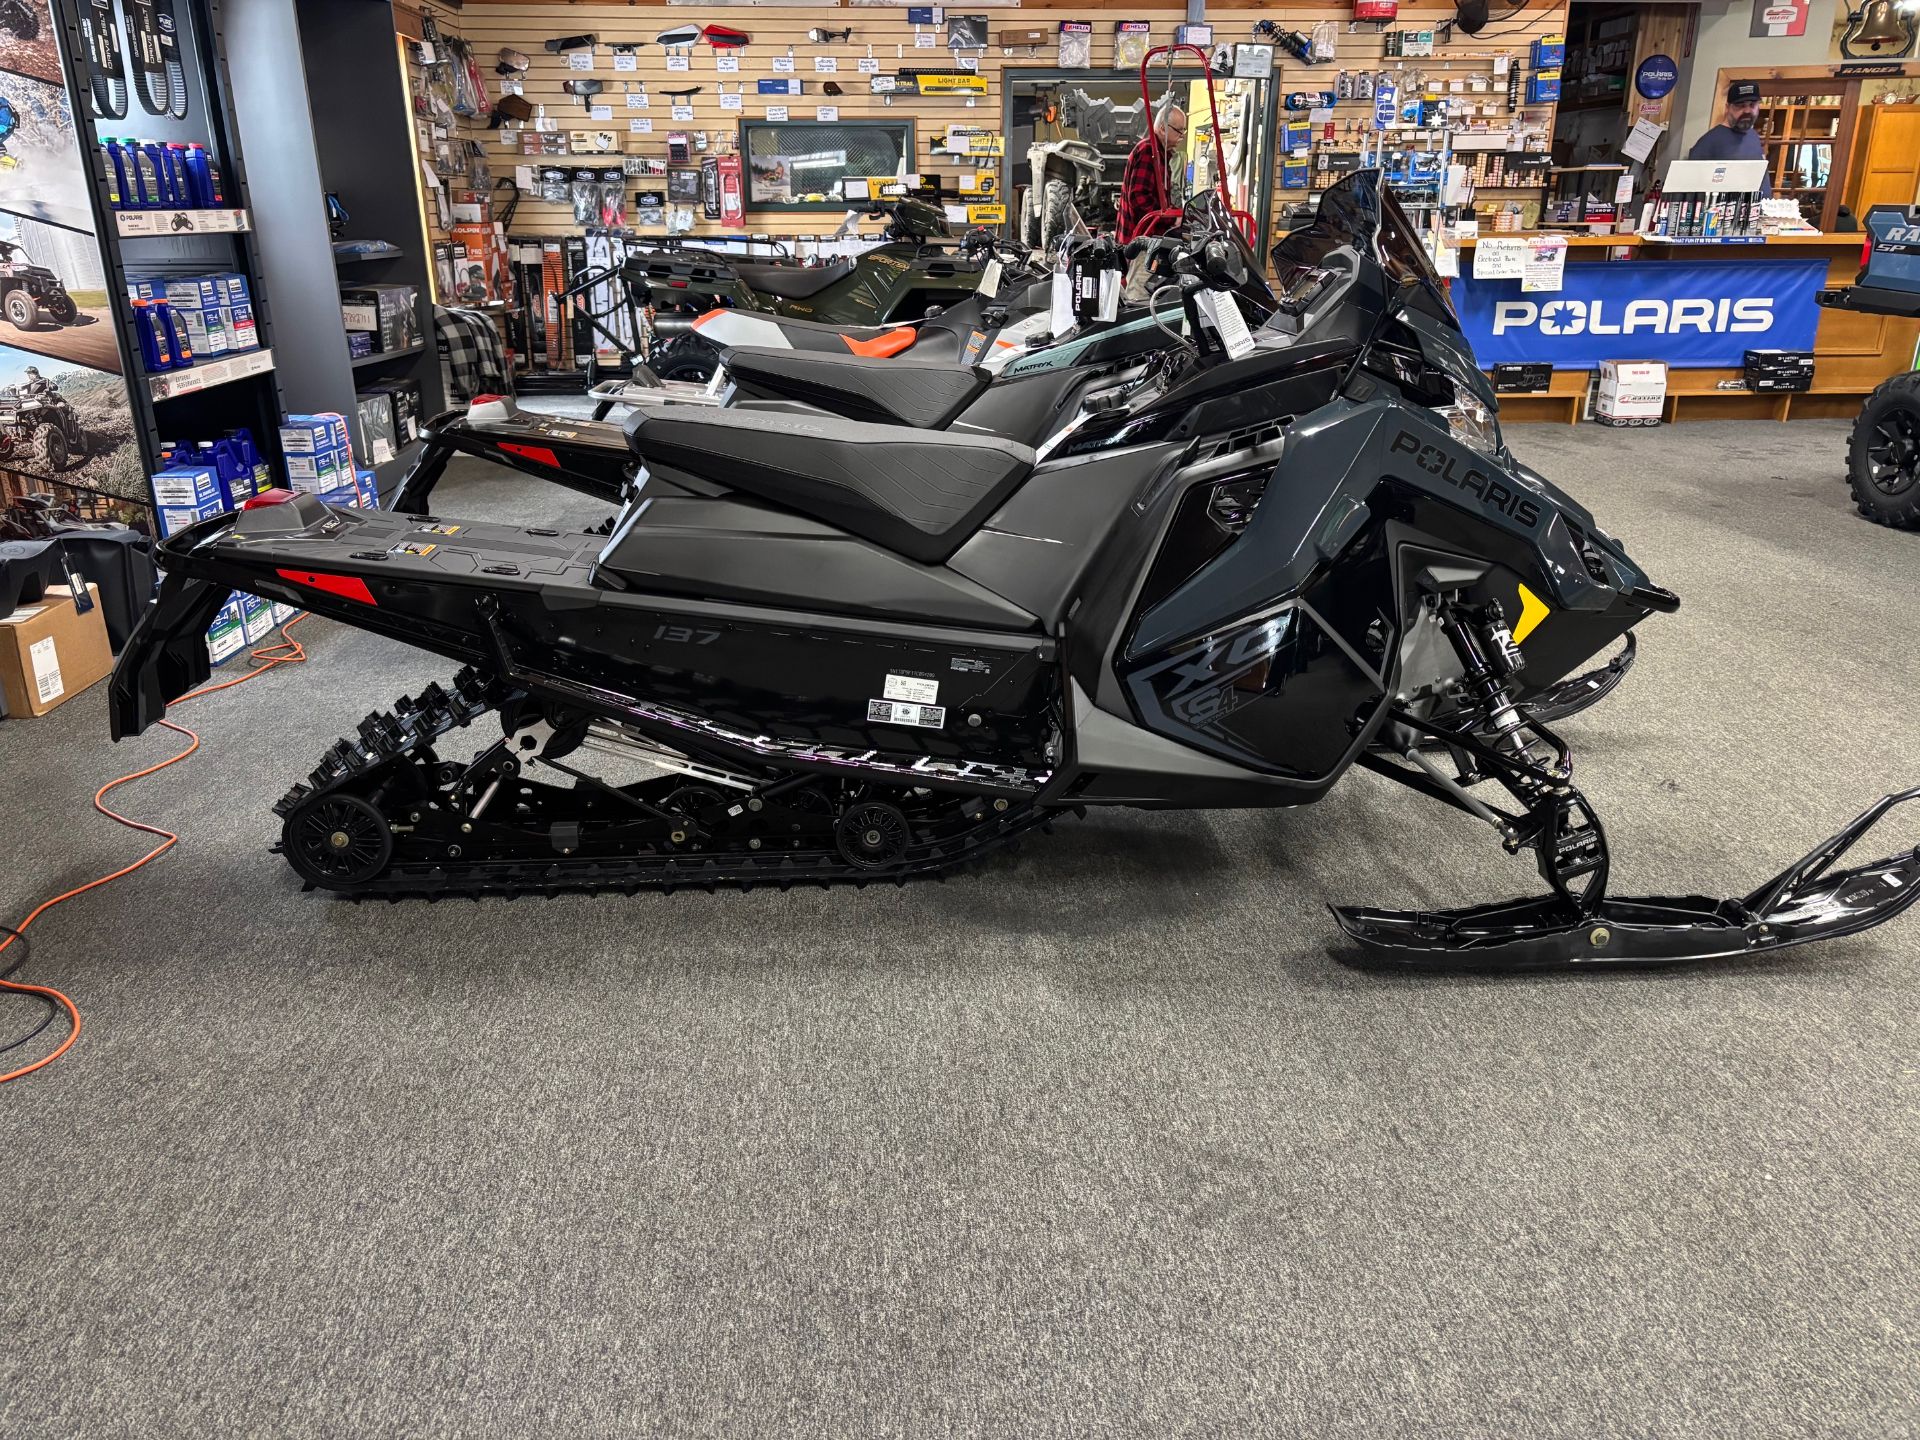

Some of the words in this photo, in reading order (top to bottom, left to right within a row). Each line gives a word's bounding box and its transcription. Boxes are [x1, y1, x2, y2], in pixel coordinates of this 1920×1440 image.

[1842, 66, 1900, 74] RANGER
[1482, 241, 1492, 249] No
[1497, 241, 1522, 250] Returns
[1493, 298, 1774, 335] POLARIS
[1014, 361, 1054, 374] MATRYX
[1390, 430, 1542, 528] POLARIS
[654, 625, 720, 645] 137
[1559, 836, 1597, 854] POLARIS
